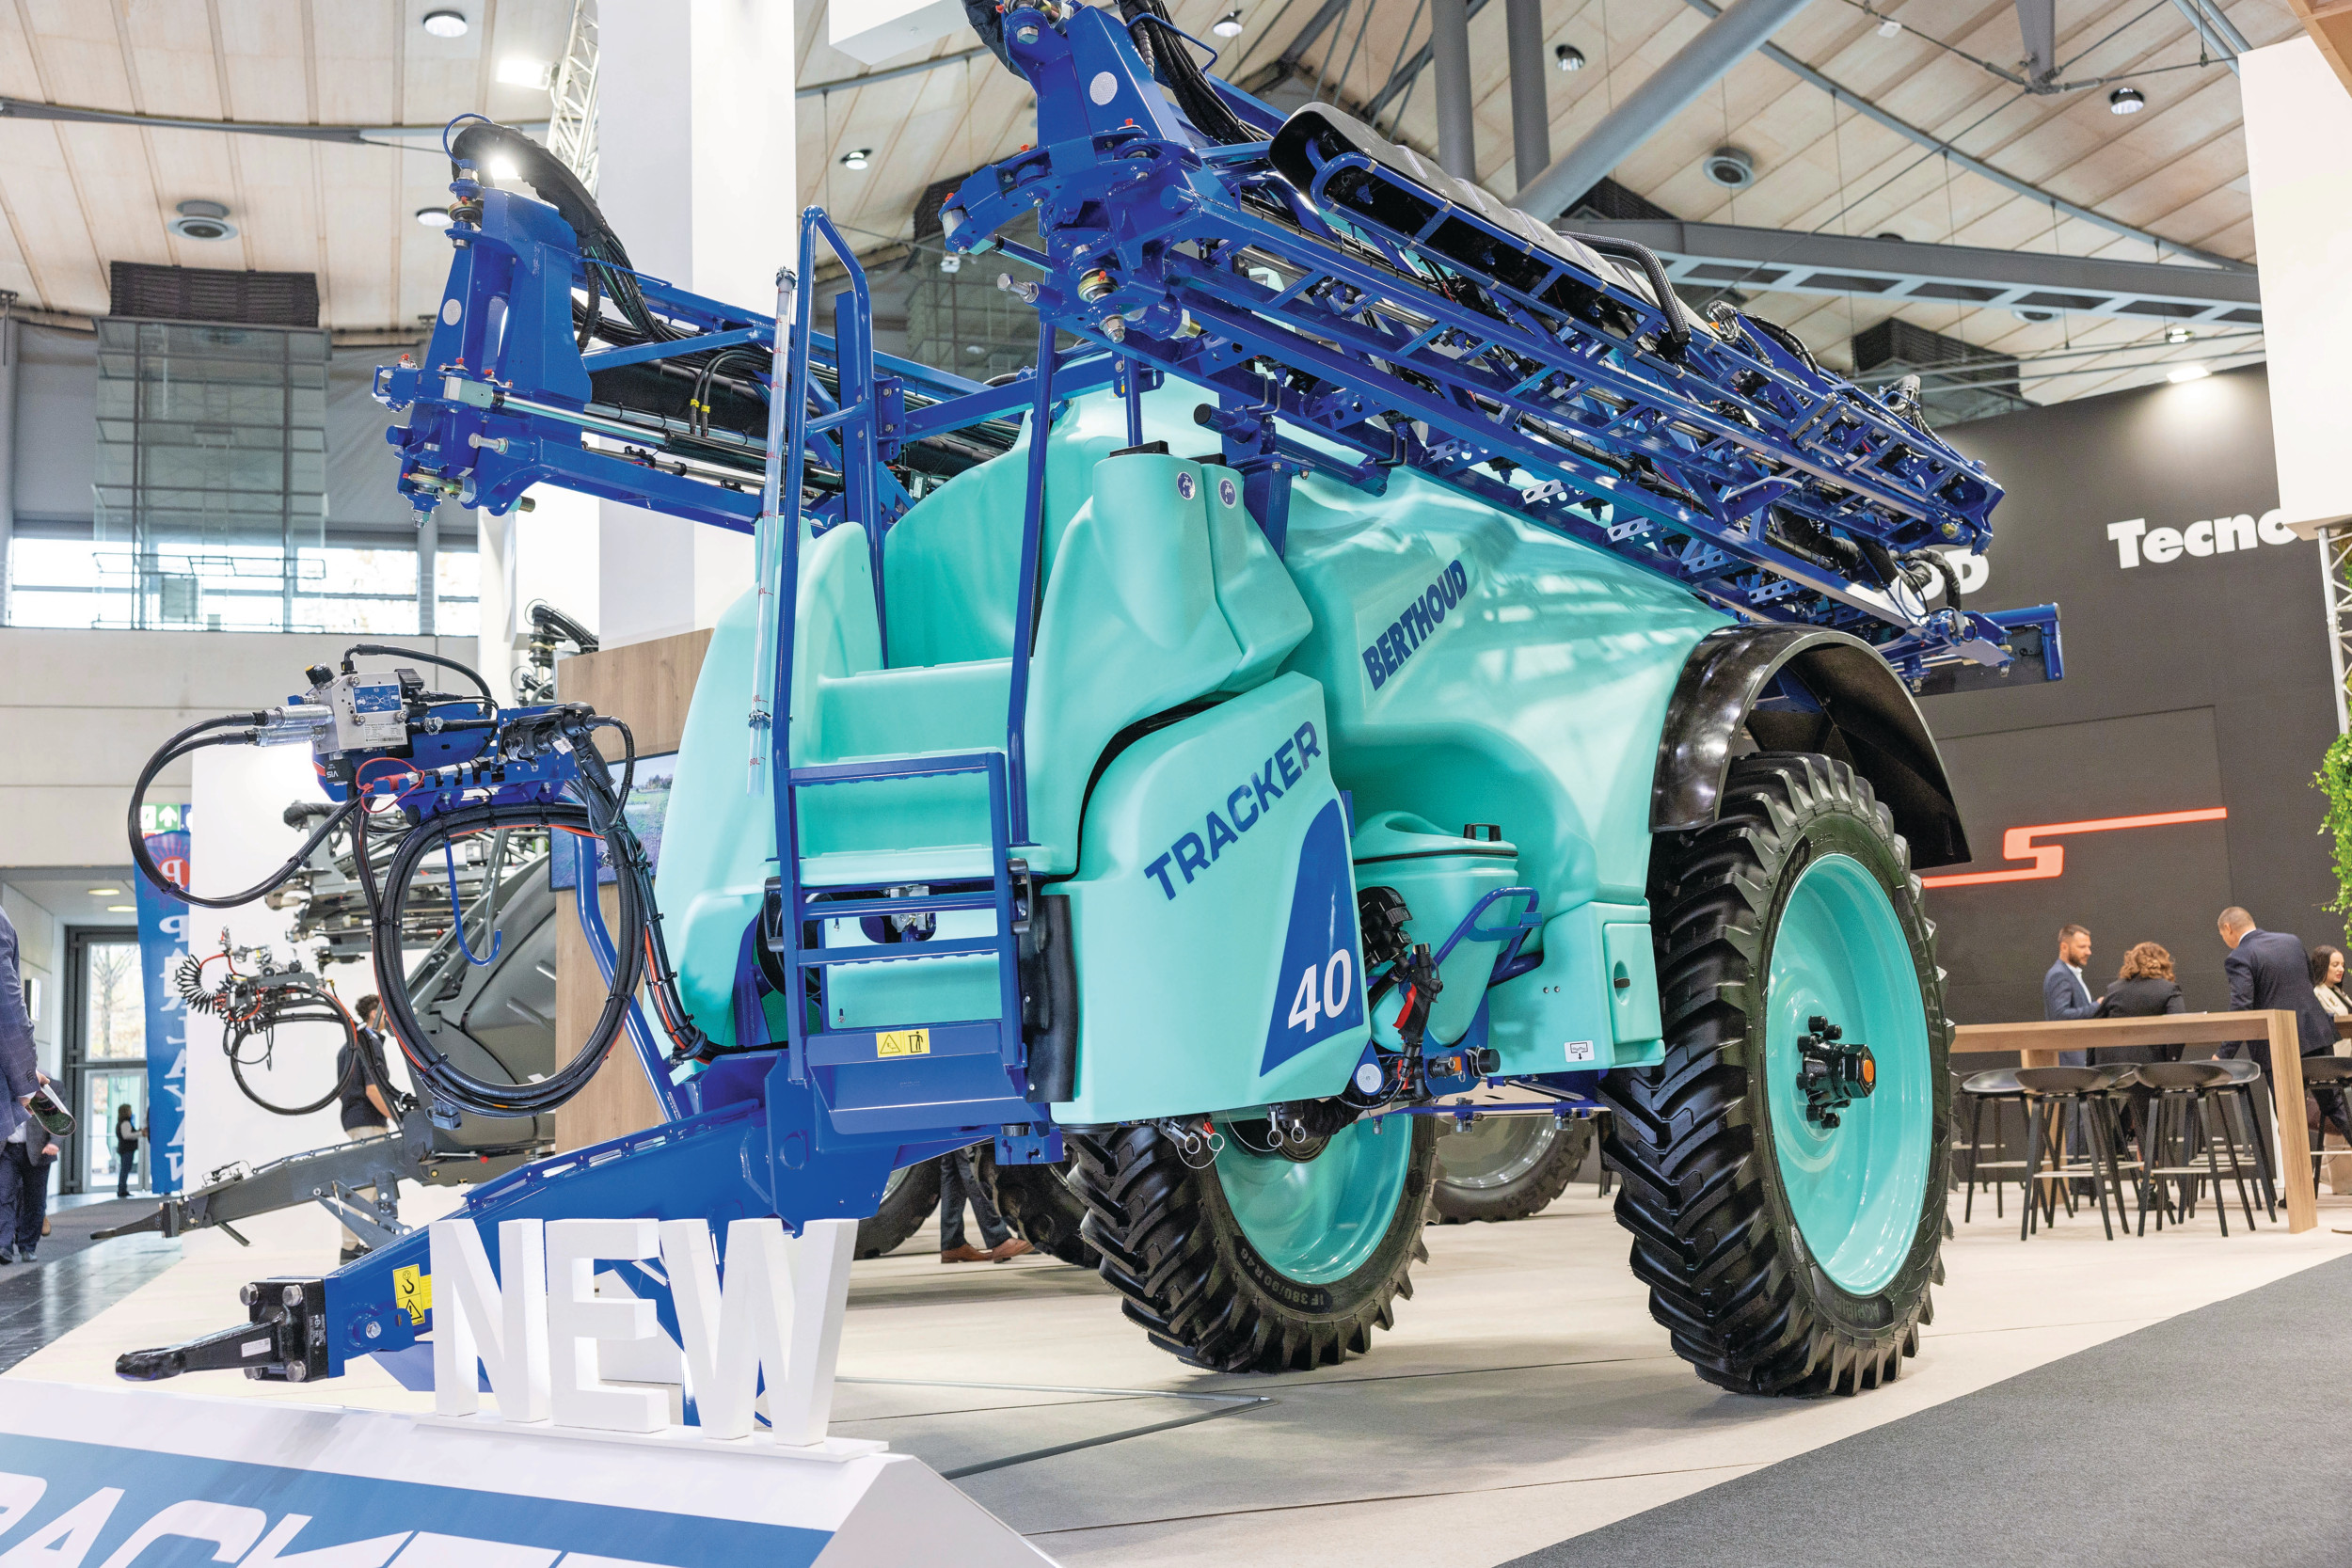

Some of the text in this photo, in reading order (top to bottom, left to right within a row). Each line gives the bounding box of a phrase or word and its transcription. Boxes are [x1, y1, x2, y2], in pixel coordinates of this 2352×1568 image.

[1361, 559, 1468, 691] BERTHOUD
[1143, 721, 1322, 901] TRACKER
[1288, 948, 1352, 1034] 40
[429, 1218, 859, 1447] NEW
